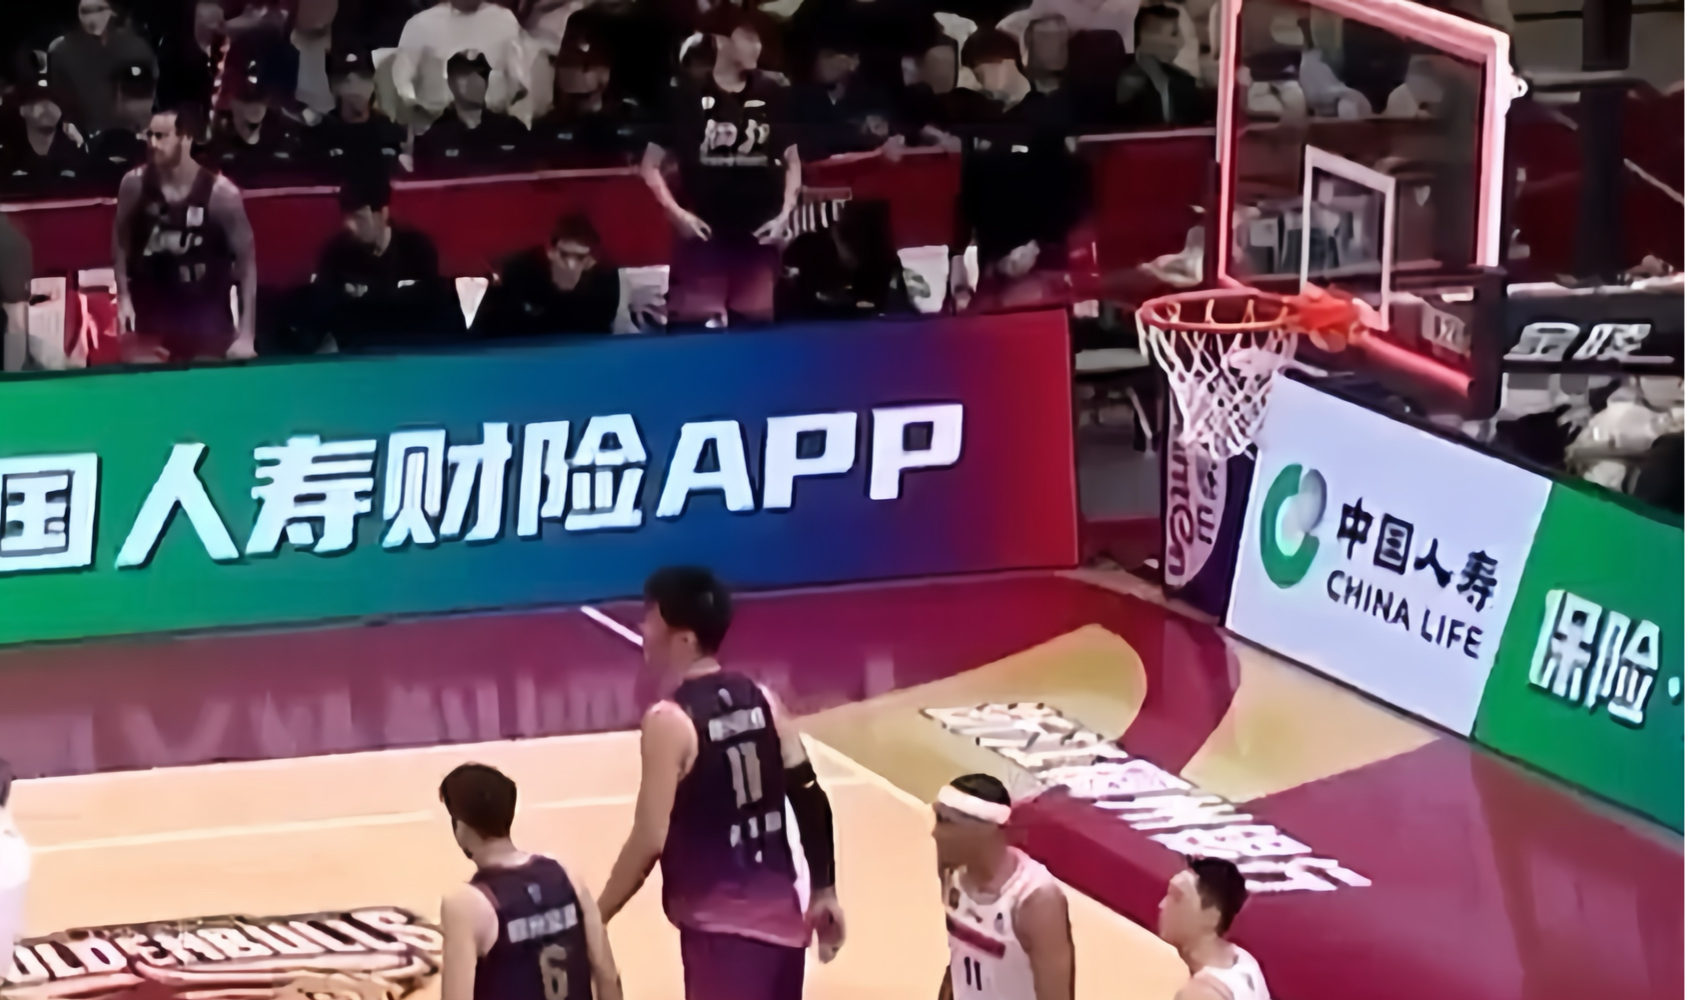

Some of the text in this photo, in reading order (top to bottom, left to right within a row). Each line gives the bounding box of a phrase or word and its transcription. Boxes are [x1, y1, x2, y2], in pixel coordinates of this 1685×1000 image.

[1337, 496, 1498, 612] 中国人寿
[1326, 569, 1483, 659] CHINA LIFE
[964, 956, 982, 992] 11
